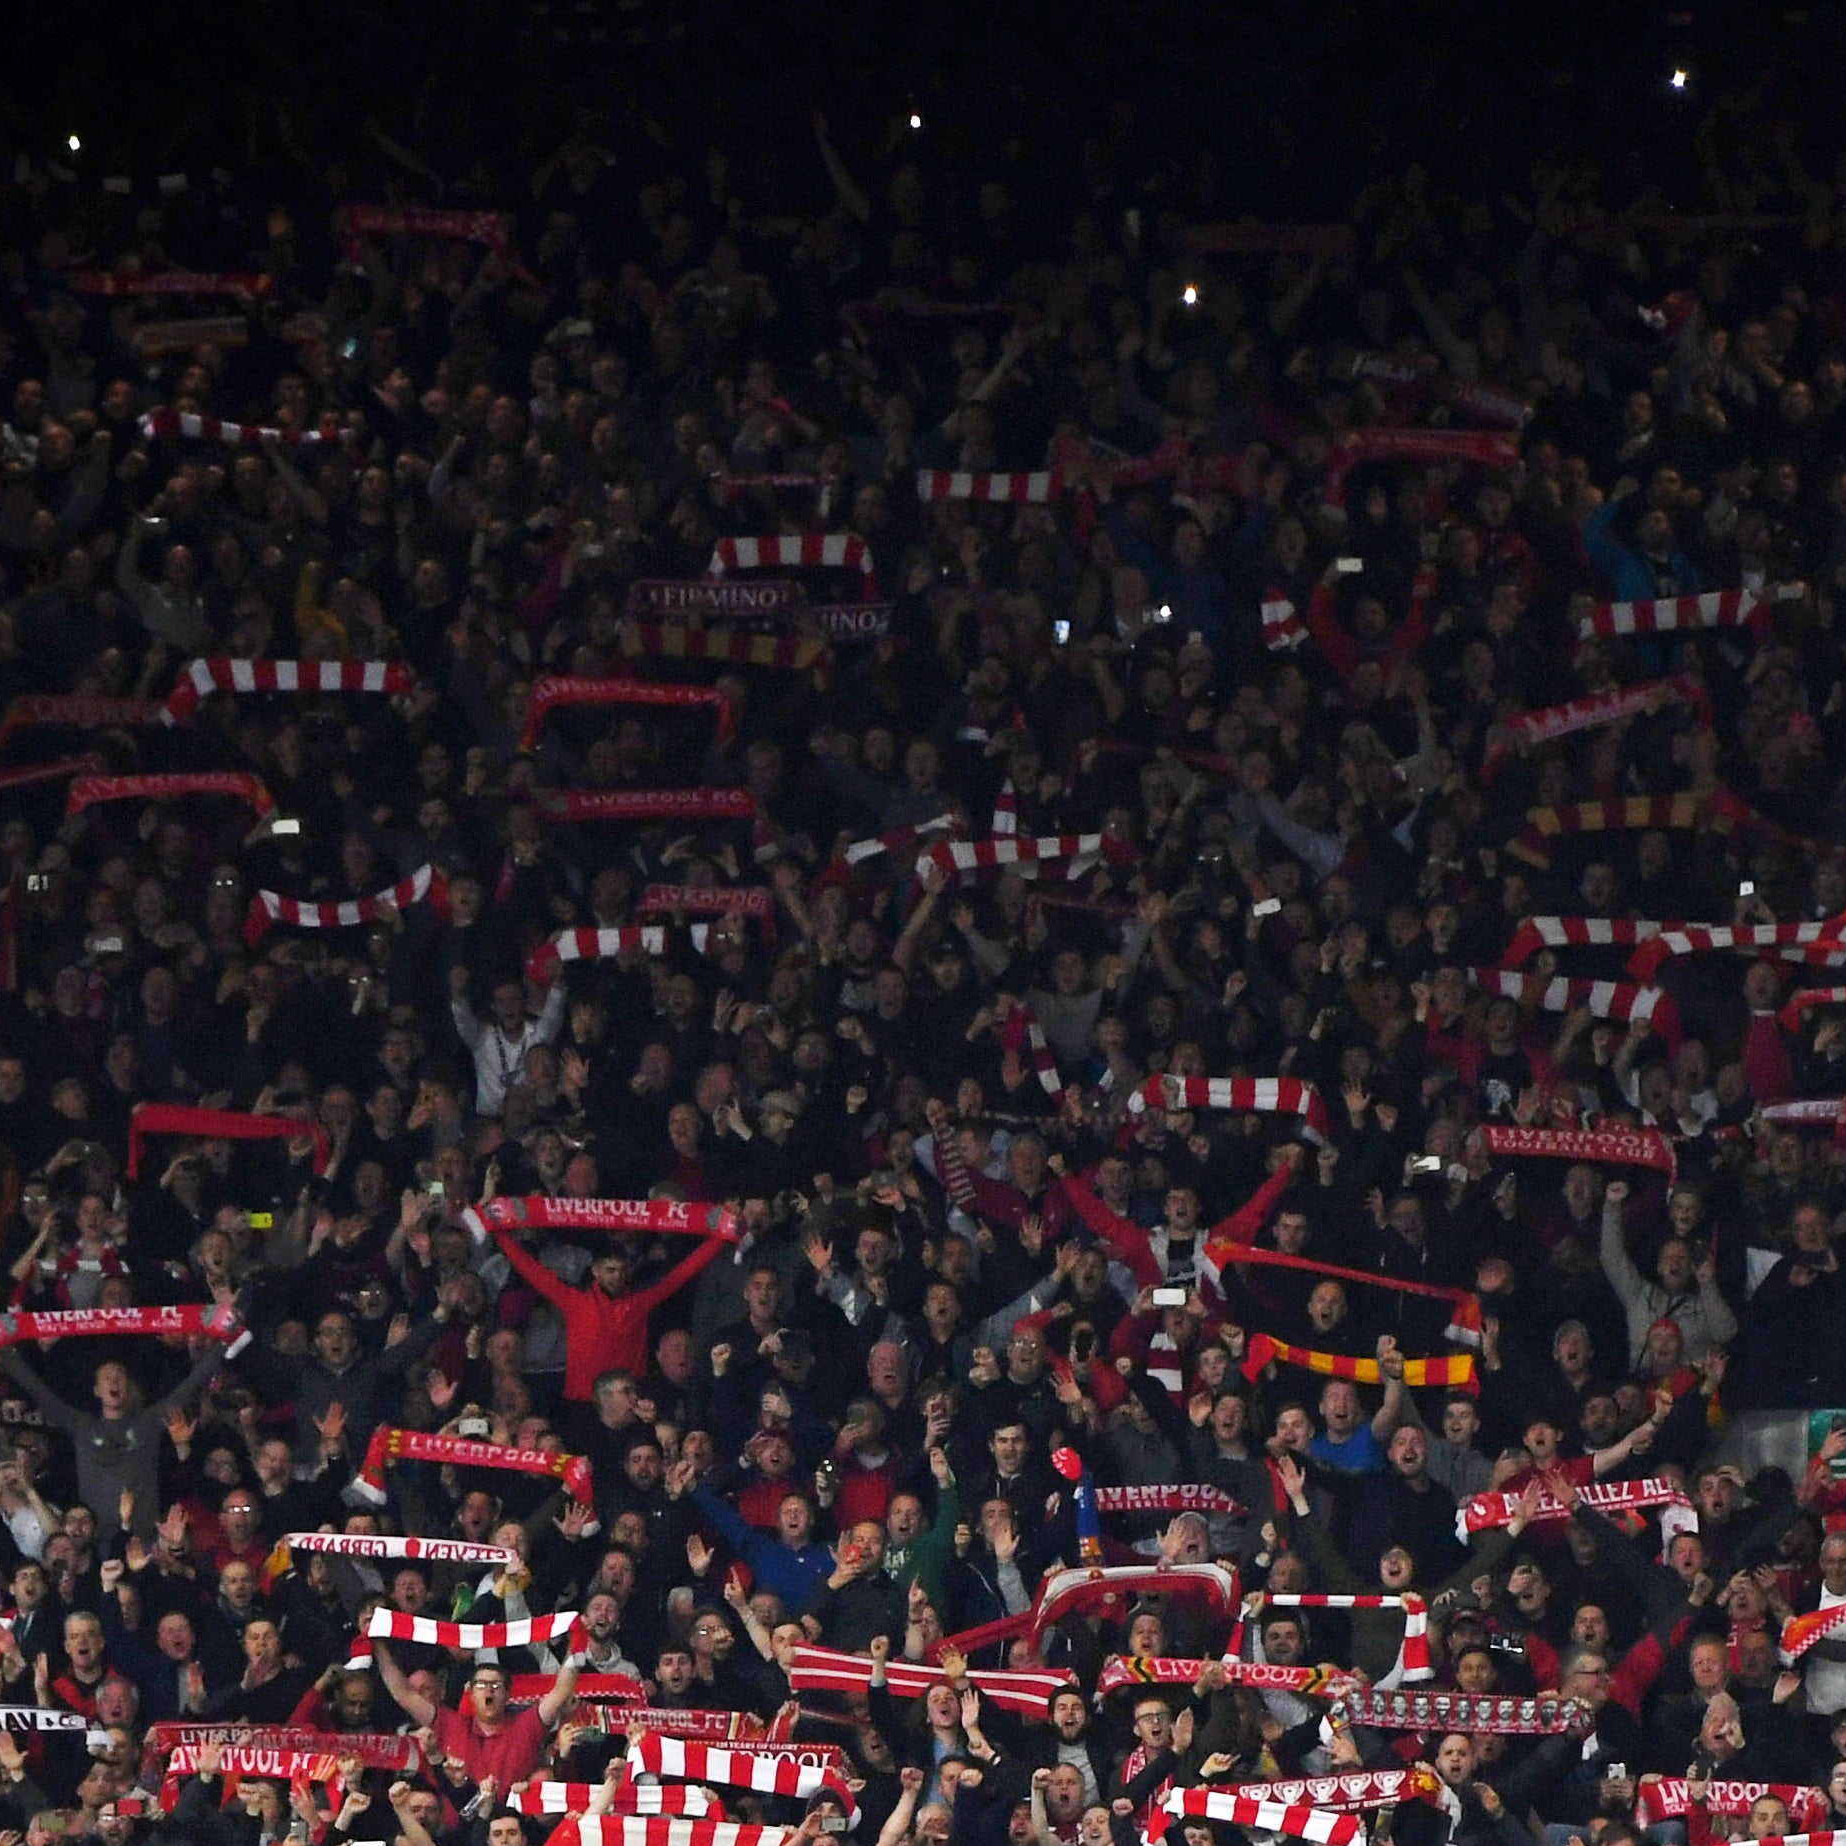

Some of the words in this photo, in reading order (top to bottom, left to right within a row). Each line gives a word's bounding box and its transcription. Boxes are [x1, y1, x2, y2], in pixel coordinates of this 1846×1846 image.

[543, 1198, 651, 1217] LIVERPOOL
[667, 1201, 690, 1219] FC
[33, 1306, 144, 1325] LIVERPOOL
[410, 1437, 548, 1466] LIVERPOOL
[1575, 1481, 1634, 1506] ALLEZ
[607, 1707, 699, 1725] LIVERPOOL
[704, 1712, 726, 1730] FC
